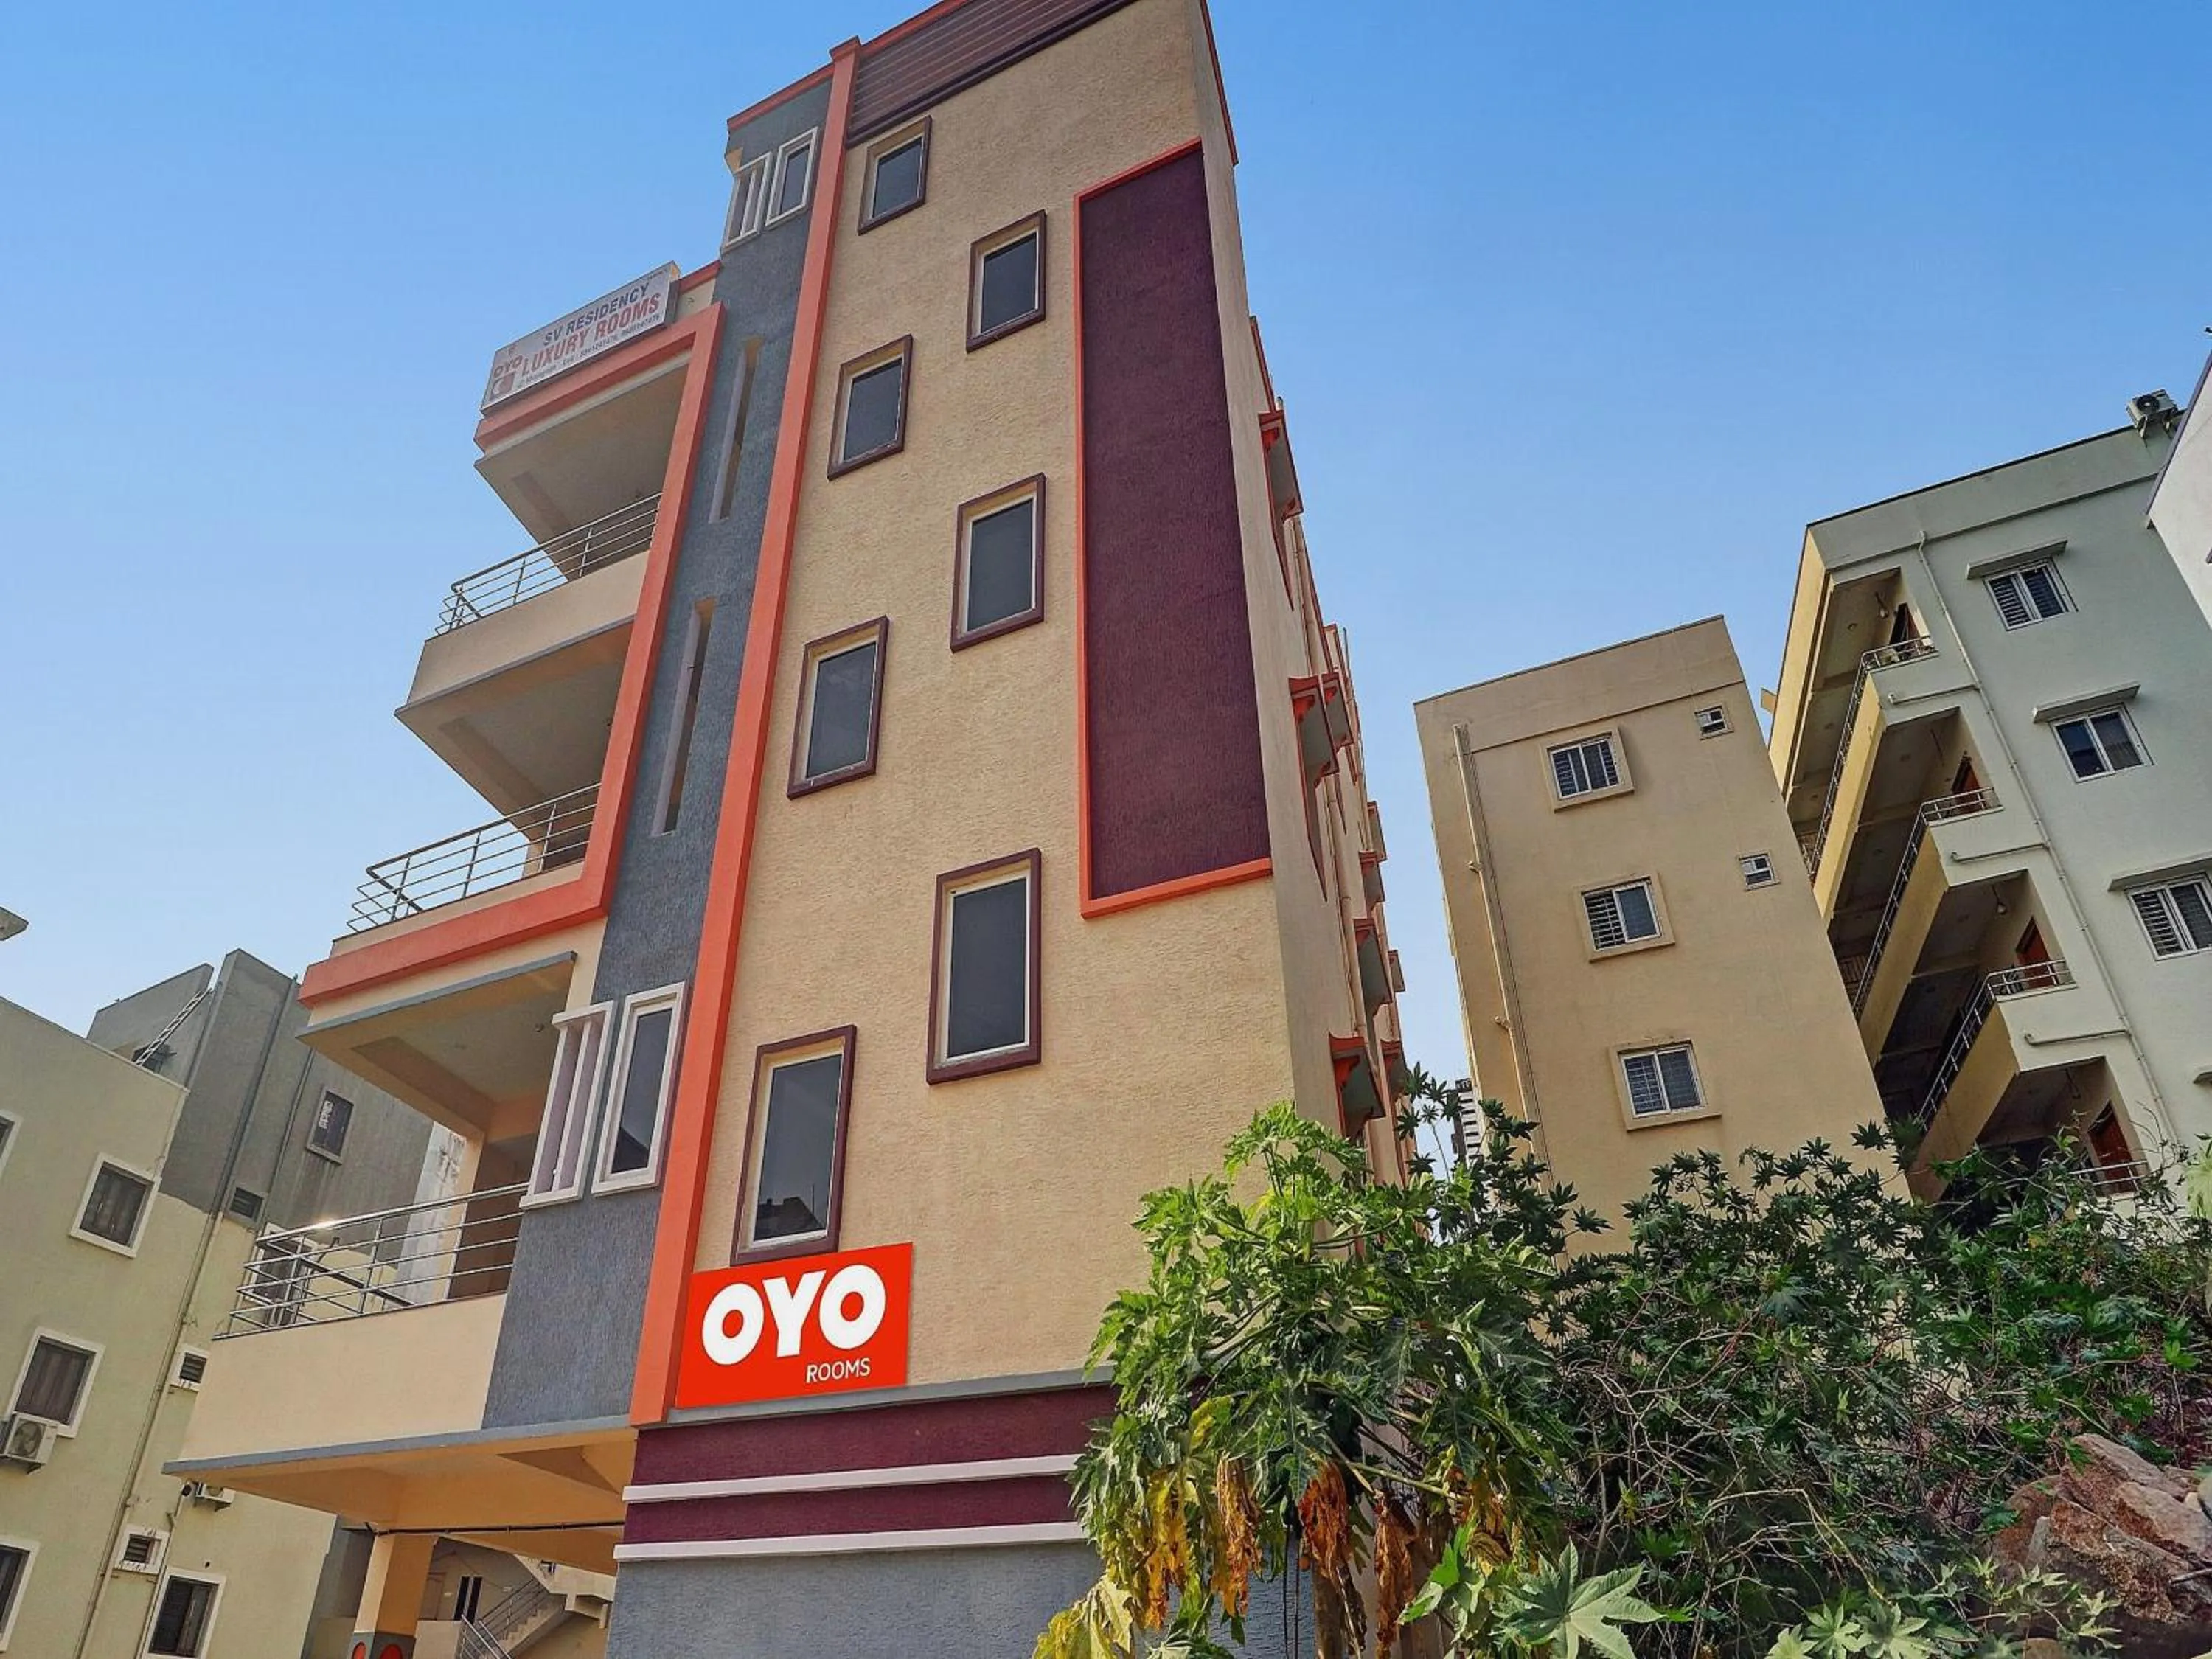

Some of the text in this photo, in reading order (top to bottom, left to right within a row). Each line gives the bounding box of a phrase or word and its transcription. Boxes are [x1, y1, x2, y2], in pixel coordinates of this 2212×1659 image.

[521, 329, 588, 376] LUXURY
[594, 293, 661, 342] ROOMS
[543, 282, 650, 346] SV RESIDENCY
[493, 355, 523, 378] OYO
[702, 1265, 886, 1365] OYO
[805, 1357, 872, 1383] ROOMS
